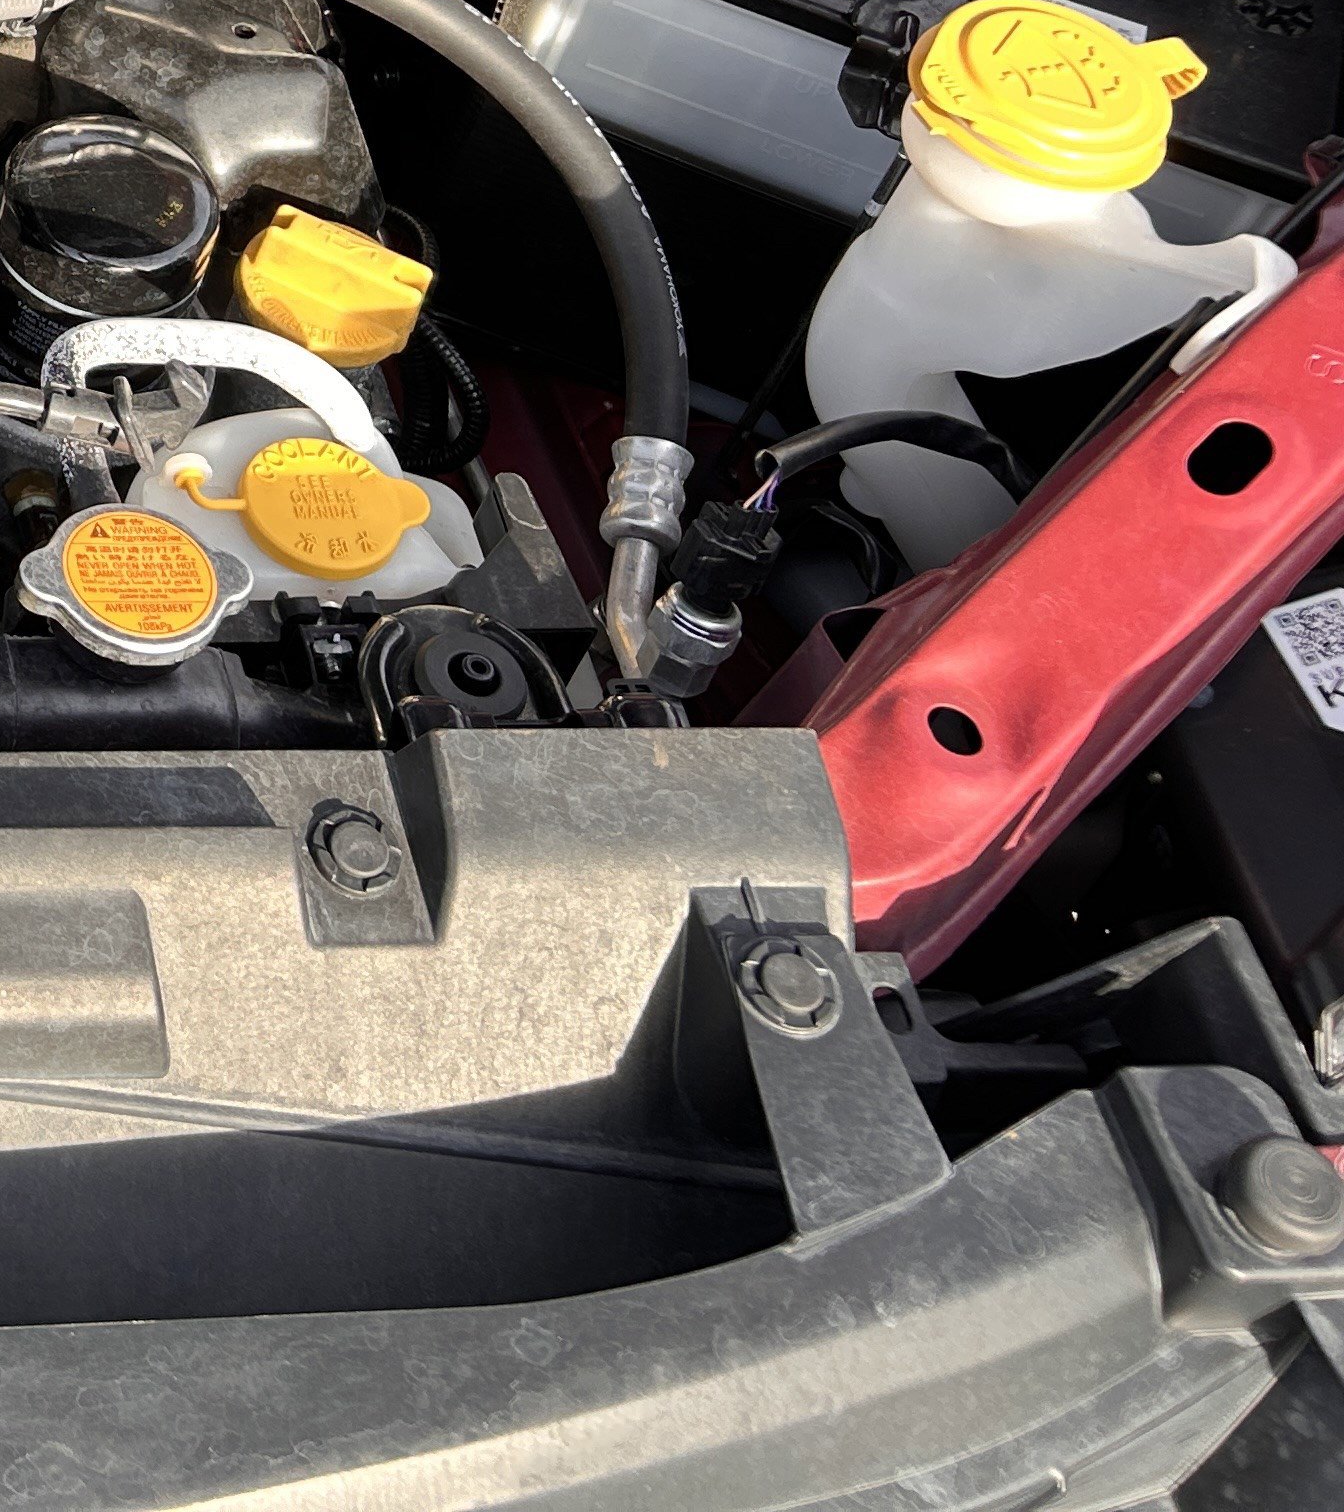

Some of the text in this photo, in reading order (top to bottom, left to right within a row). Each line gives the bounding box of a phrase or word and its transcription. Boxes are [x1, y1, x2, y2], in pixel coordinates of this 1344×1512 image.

[252, 439, 378, 483] COOLANT
[295, 474, 332, 488] SEE
[292, 505, 358, 520] MANUAL
[109, 525, 169, 535] WARNING
[77, 561, 110, 570] NEVER
[113, 561, 139, 570] OPEN
[143, 561, 174, 571] WHEN
[105, 603, 193, 613] AVERTISSEMENT
